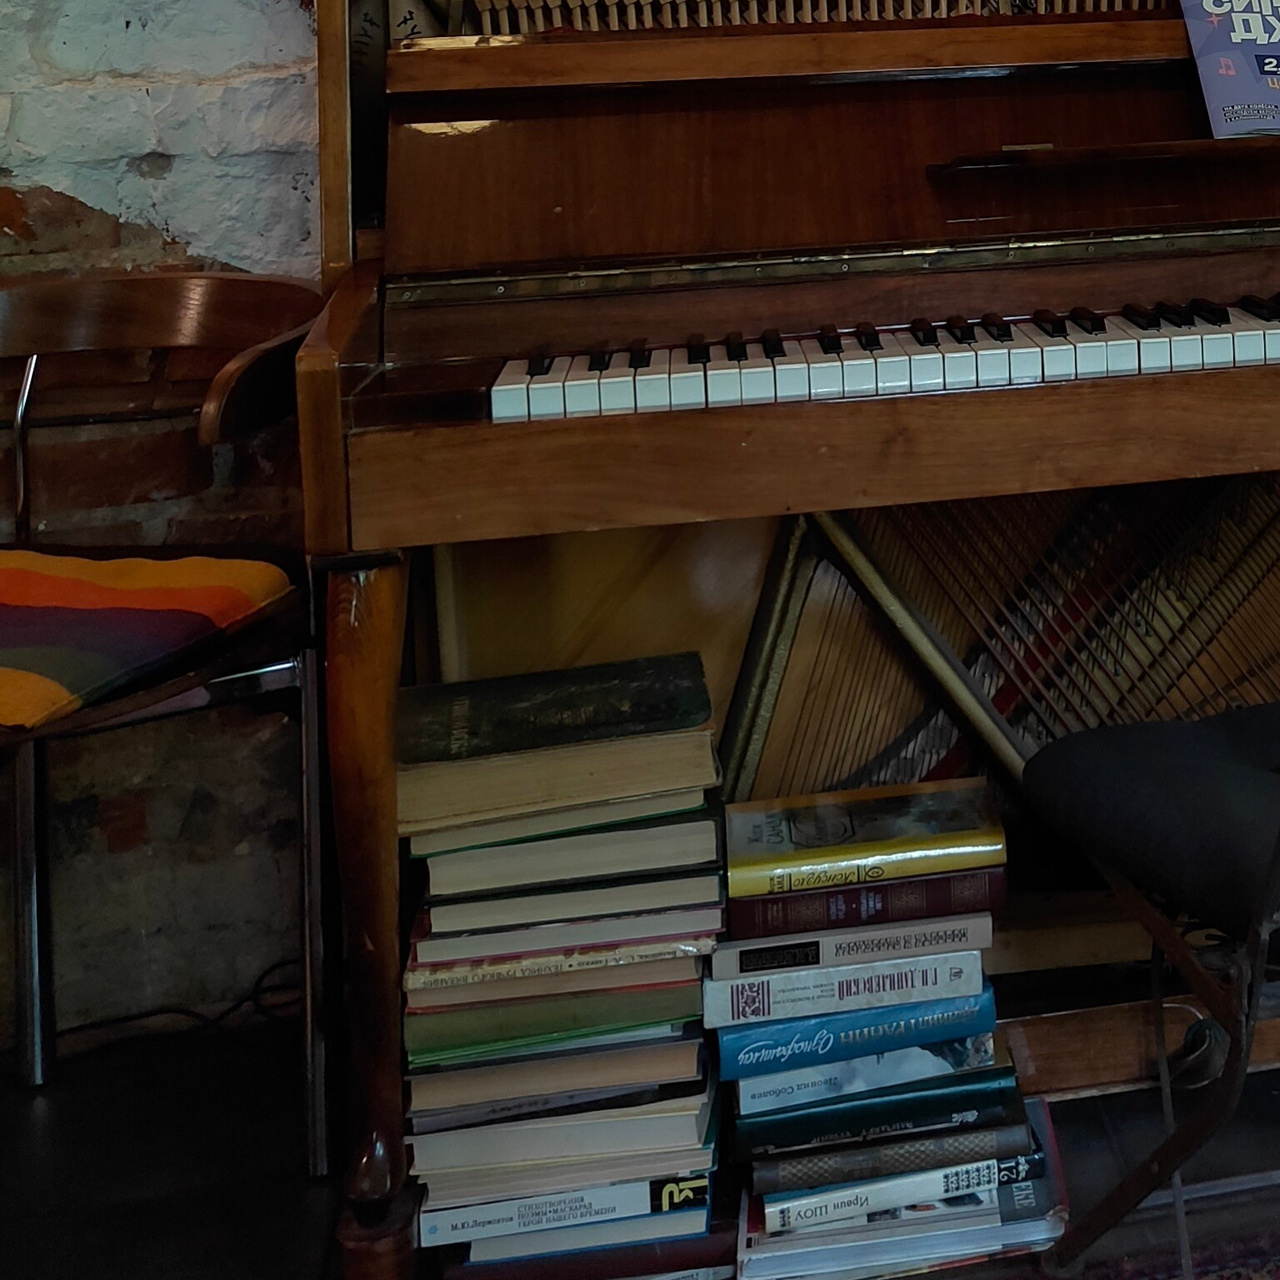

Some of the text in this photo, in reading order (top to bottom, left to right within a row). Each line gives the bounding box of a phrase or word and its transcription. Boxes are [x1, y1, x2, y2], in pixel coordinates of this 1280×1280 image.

[751, 1086, 794, 1101] Соболев
[998, 1158, 1017, 1183] 21
[516, 1195, 585, 1213] СТИХОТВОРЕНИЯ
[553, 1202, 593, 1215] МАСКАРАД
[794, 1195, 870, 1222] Ирвин ШОУ
[580, 1206, 617, 1219] ВРЕМЕНИ
